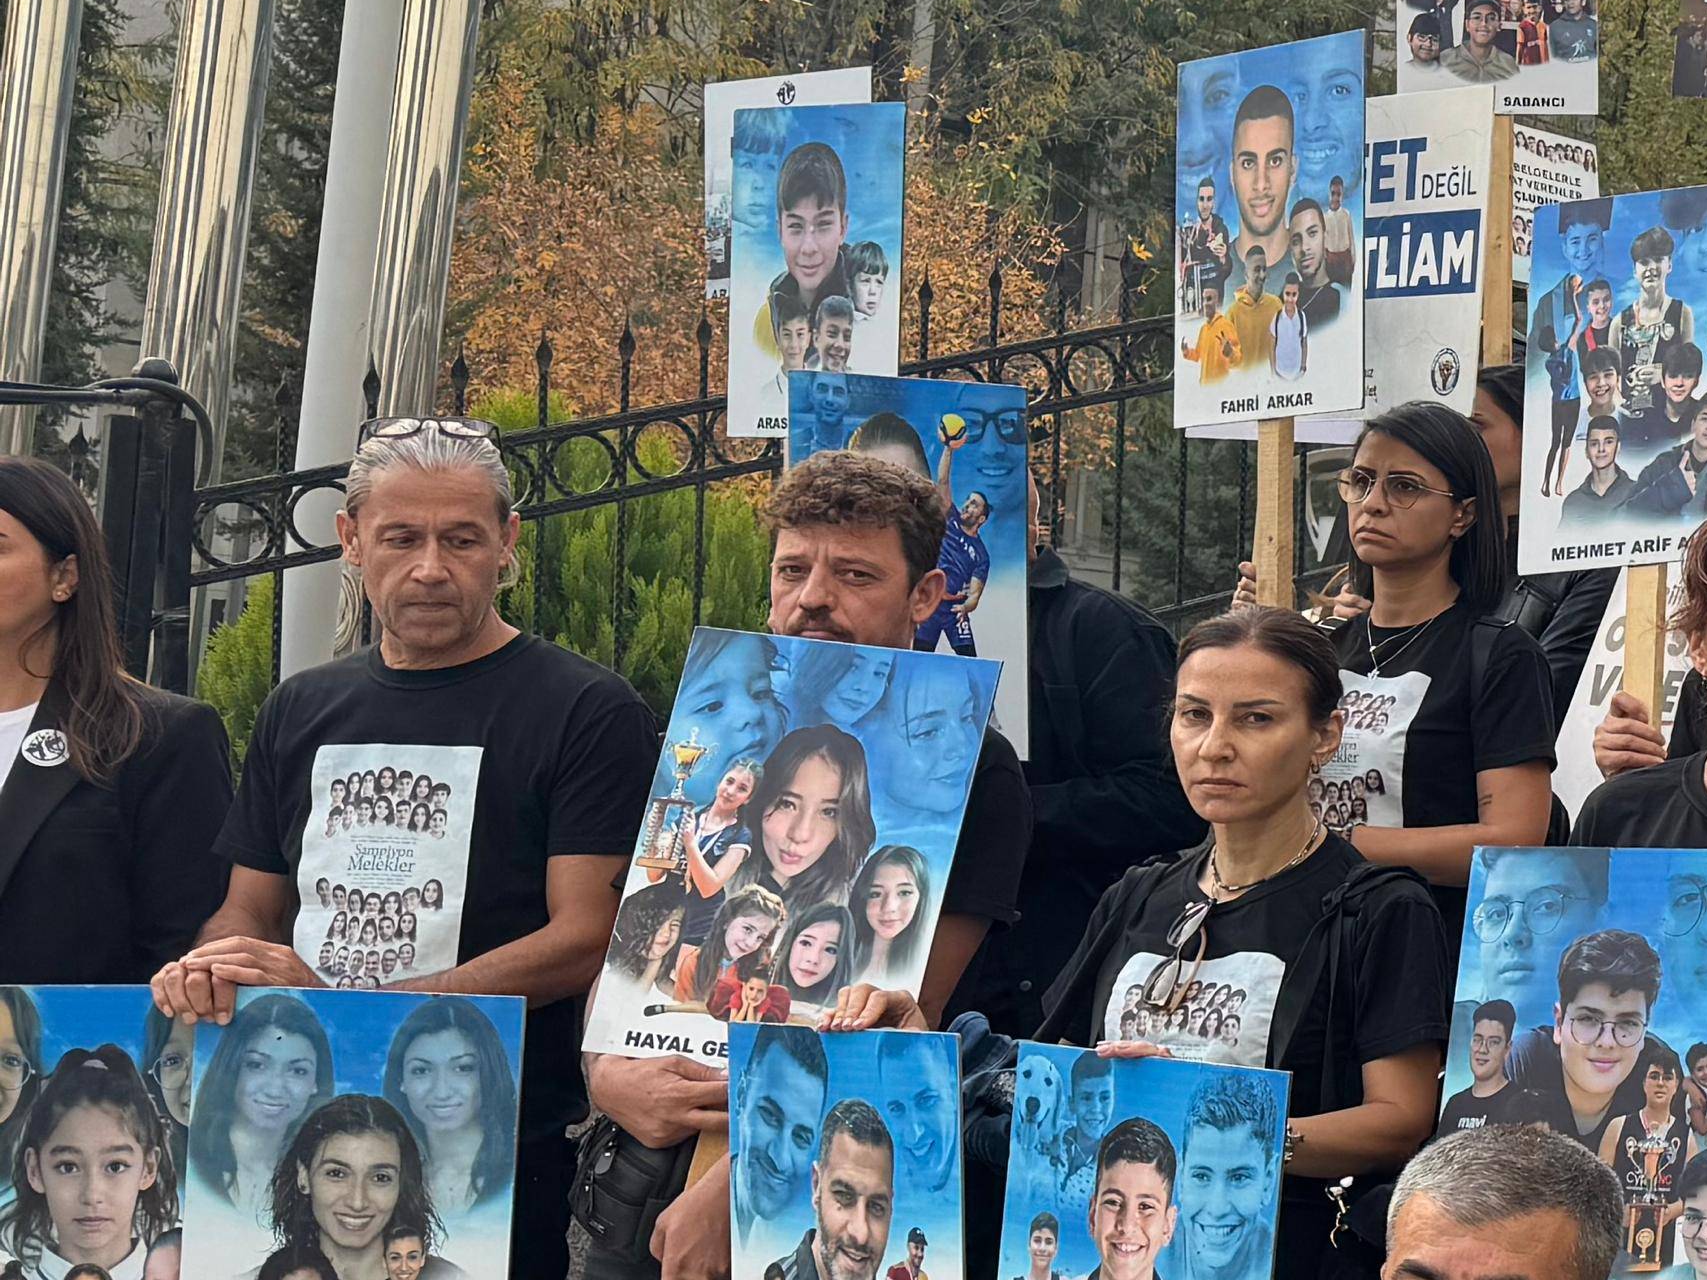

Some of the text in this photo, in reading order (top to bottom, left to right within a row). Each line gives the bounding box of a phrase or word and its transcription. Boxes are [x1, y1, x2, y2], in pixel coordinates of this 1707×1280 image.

[1421, 164, 1477, 200] DEĞİL
[1220, 391, 1313, 414] FAHRİ ARKAR
[757, 417, 788, 430] ARAS
[1551, 541, 1626, 563] MEHMET
[1630, 536, 1672, 557] ARİF
[347, 854, 416, 872] Melekler
[624, 1030, 694, 1053] HAYAL
